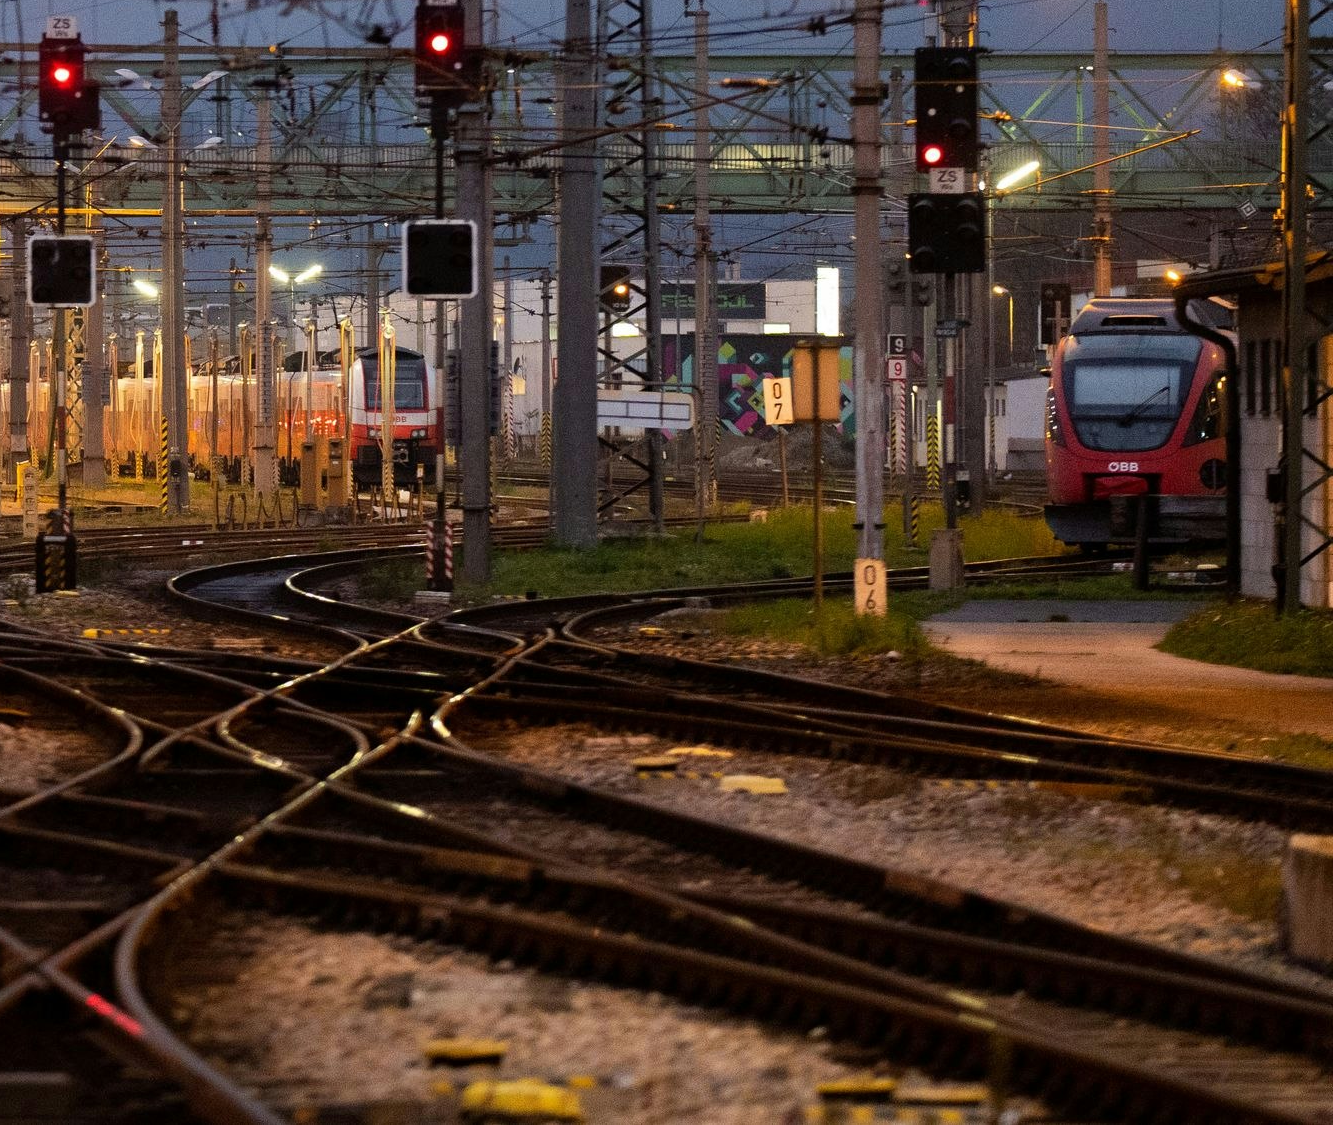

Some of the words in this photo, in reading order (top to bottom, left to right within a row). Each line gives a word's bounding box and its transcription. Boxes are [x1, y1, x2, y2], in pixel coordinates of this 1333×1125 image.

[895, 338, 904, 352] 9
[895, 362, 902, 375] 9
[1108, 461, 1139, 472] ÖBB
